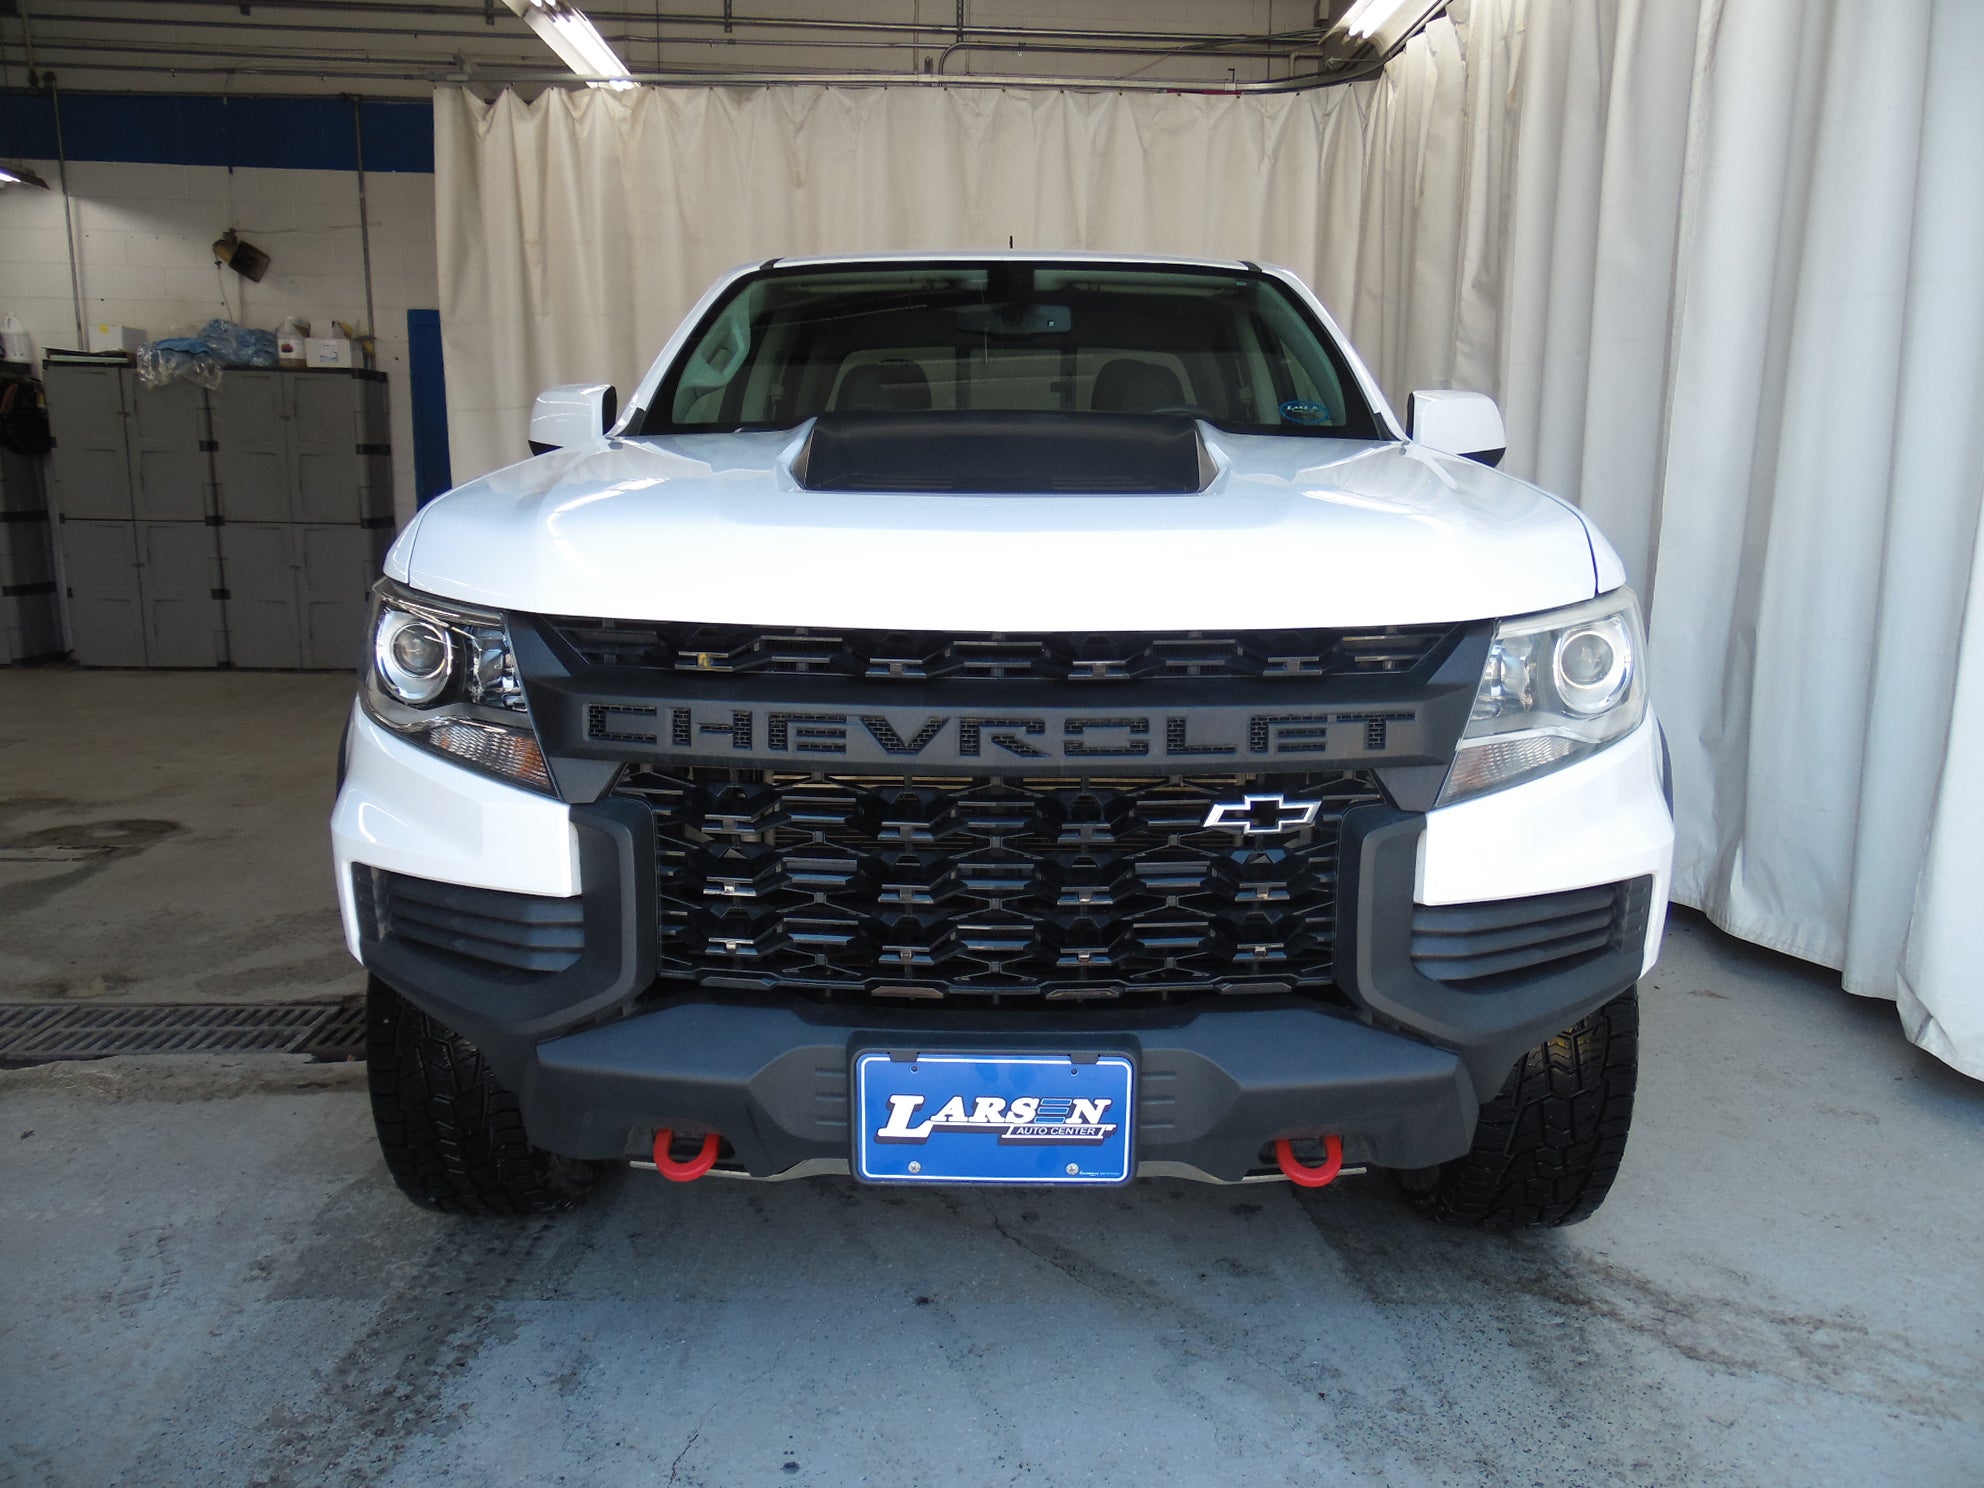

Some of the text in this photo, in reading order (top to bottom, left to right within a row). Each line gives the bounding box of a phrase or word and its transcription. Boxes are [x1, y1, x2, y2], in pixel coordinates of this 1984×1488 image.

[587, 703, 1416, 757] CHEVROLET
[877, 1094, 1112, 1138] LARSEN
[1016, 1127, 1096, 1135] AUTO CENTER
